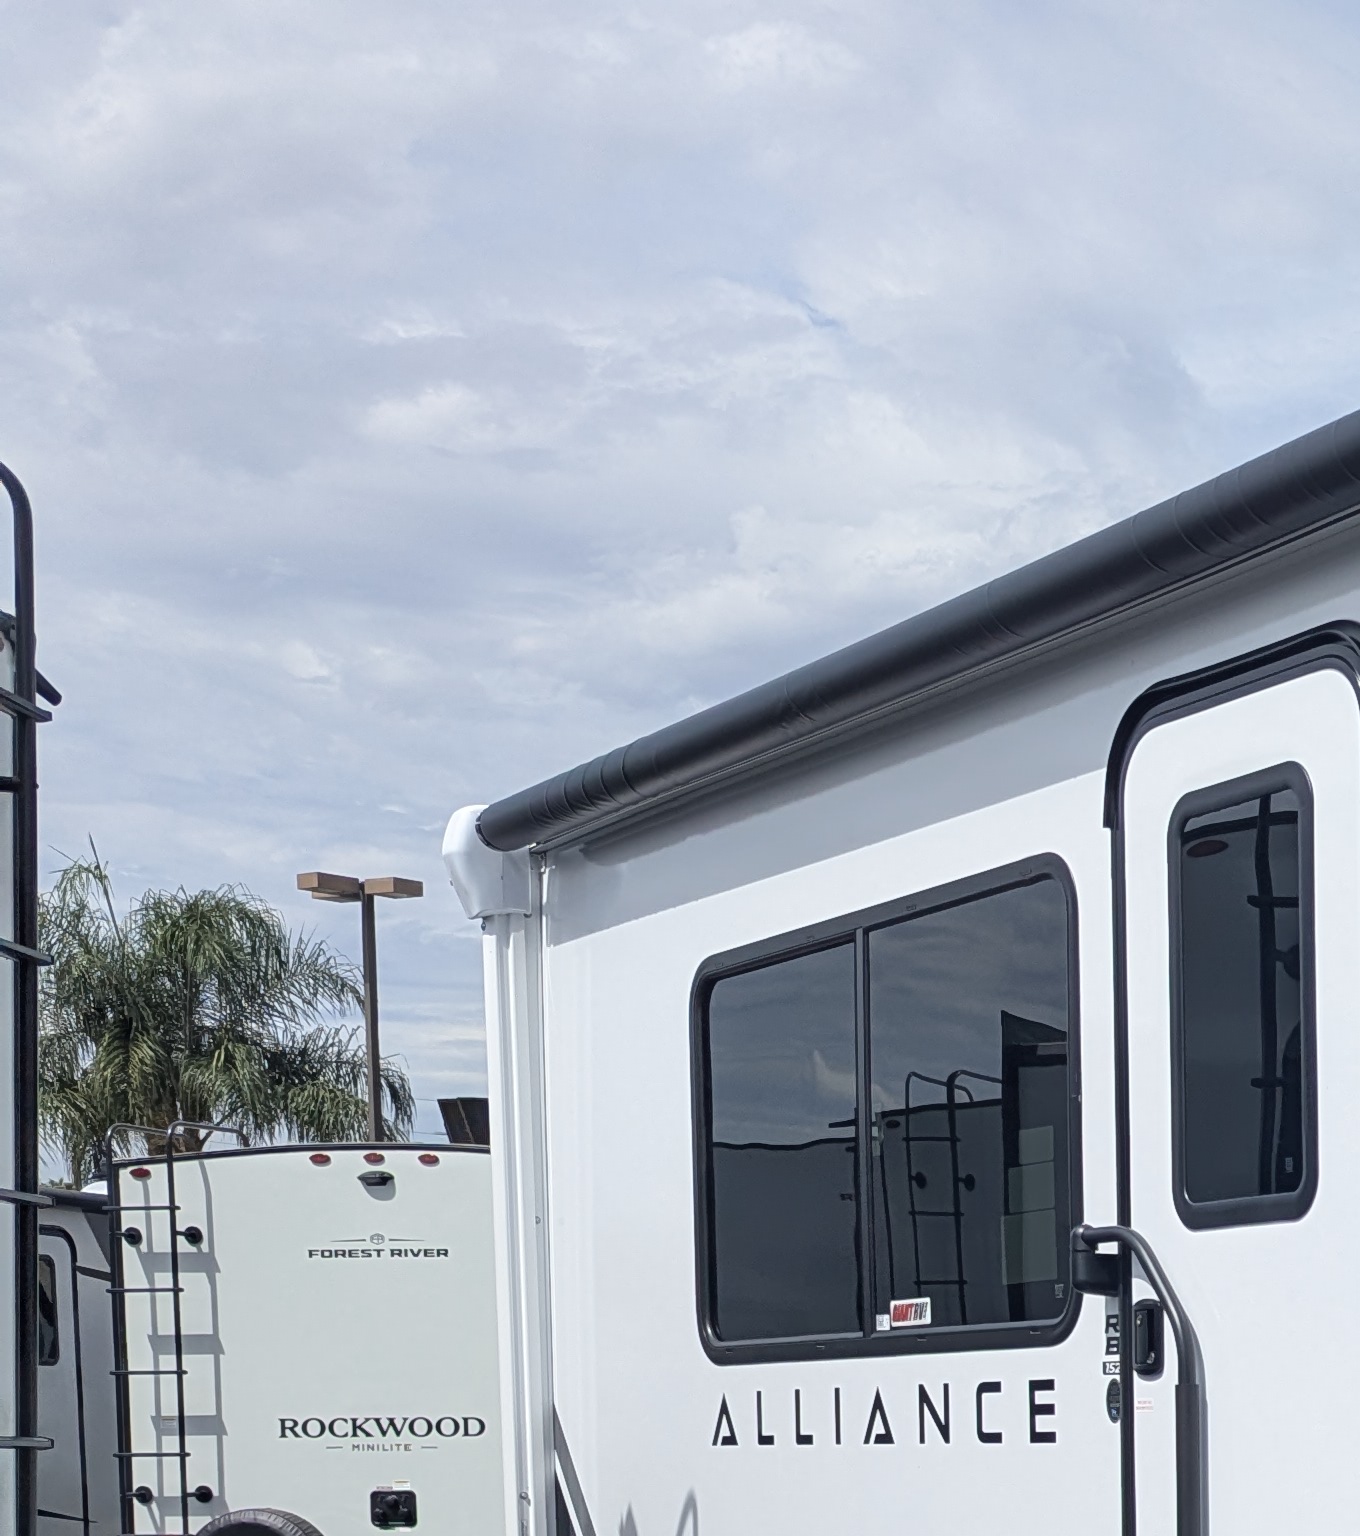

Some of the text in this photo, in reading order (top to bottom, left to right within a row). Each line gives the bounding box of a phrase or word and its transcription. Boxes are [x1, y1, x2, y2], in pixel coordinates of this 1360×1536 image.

[308, 1248, 449, 1258] FOREST RIVER
[712, 1378, 1058, 1447] ALLIANCE
[278, 1416, 486, 1438] ROCKWOOD
[352, 1443, 412, 1452] MINILITE
